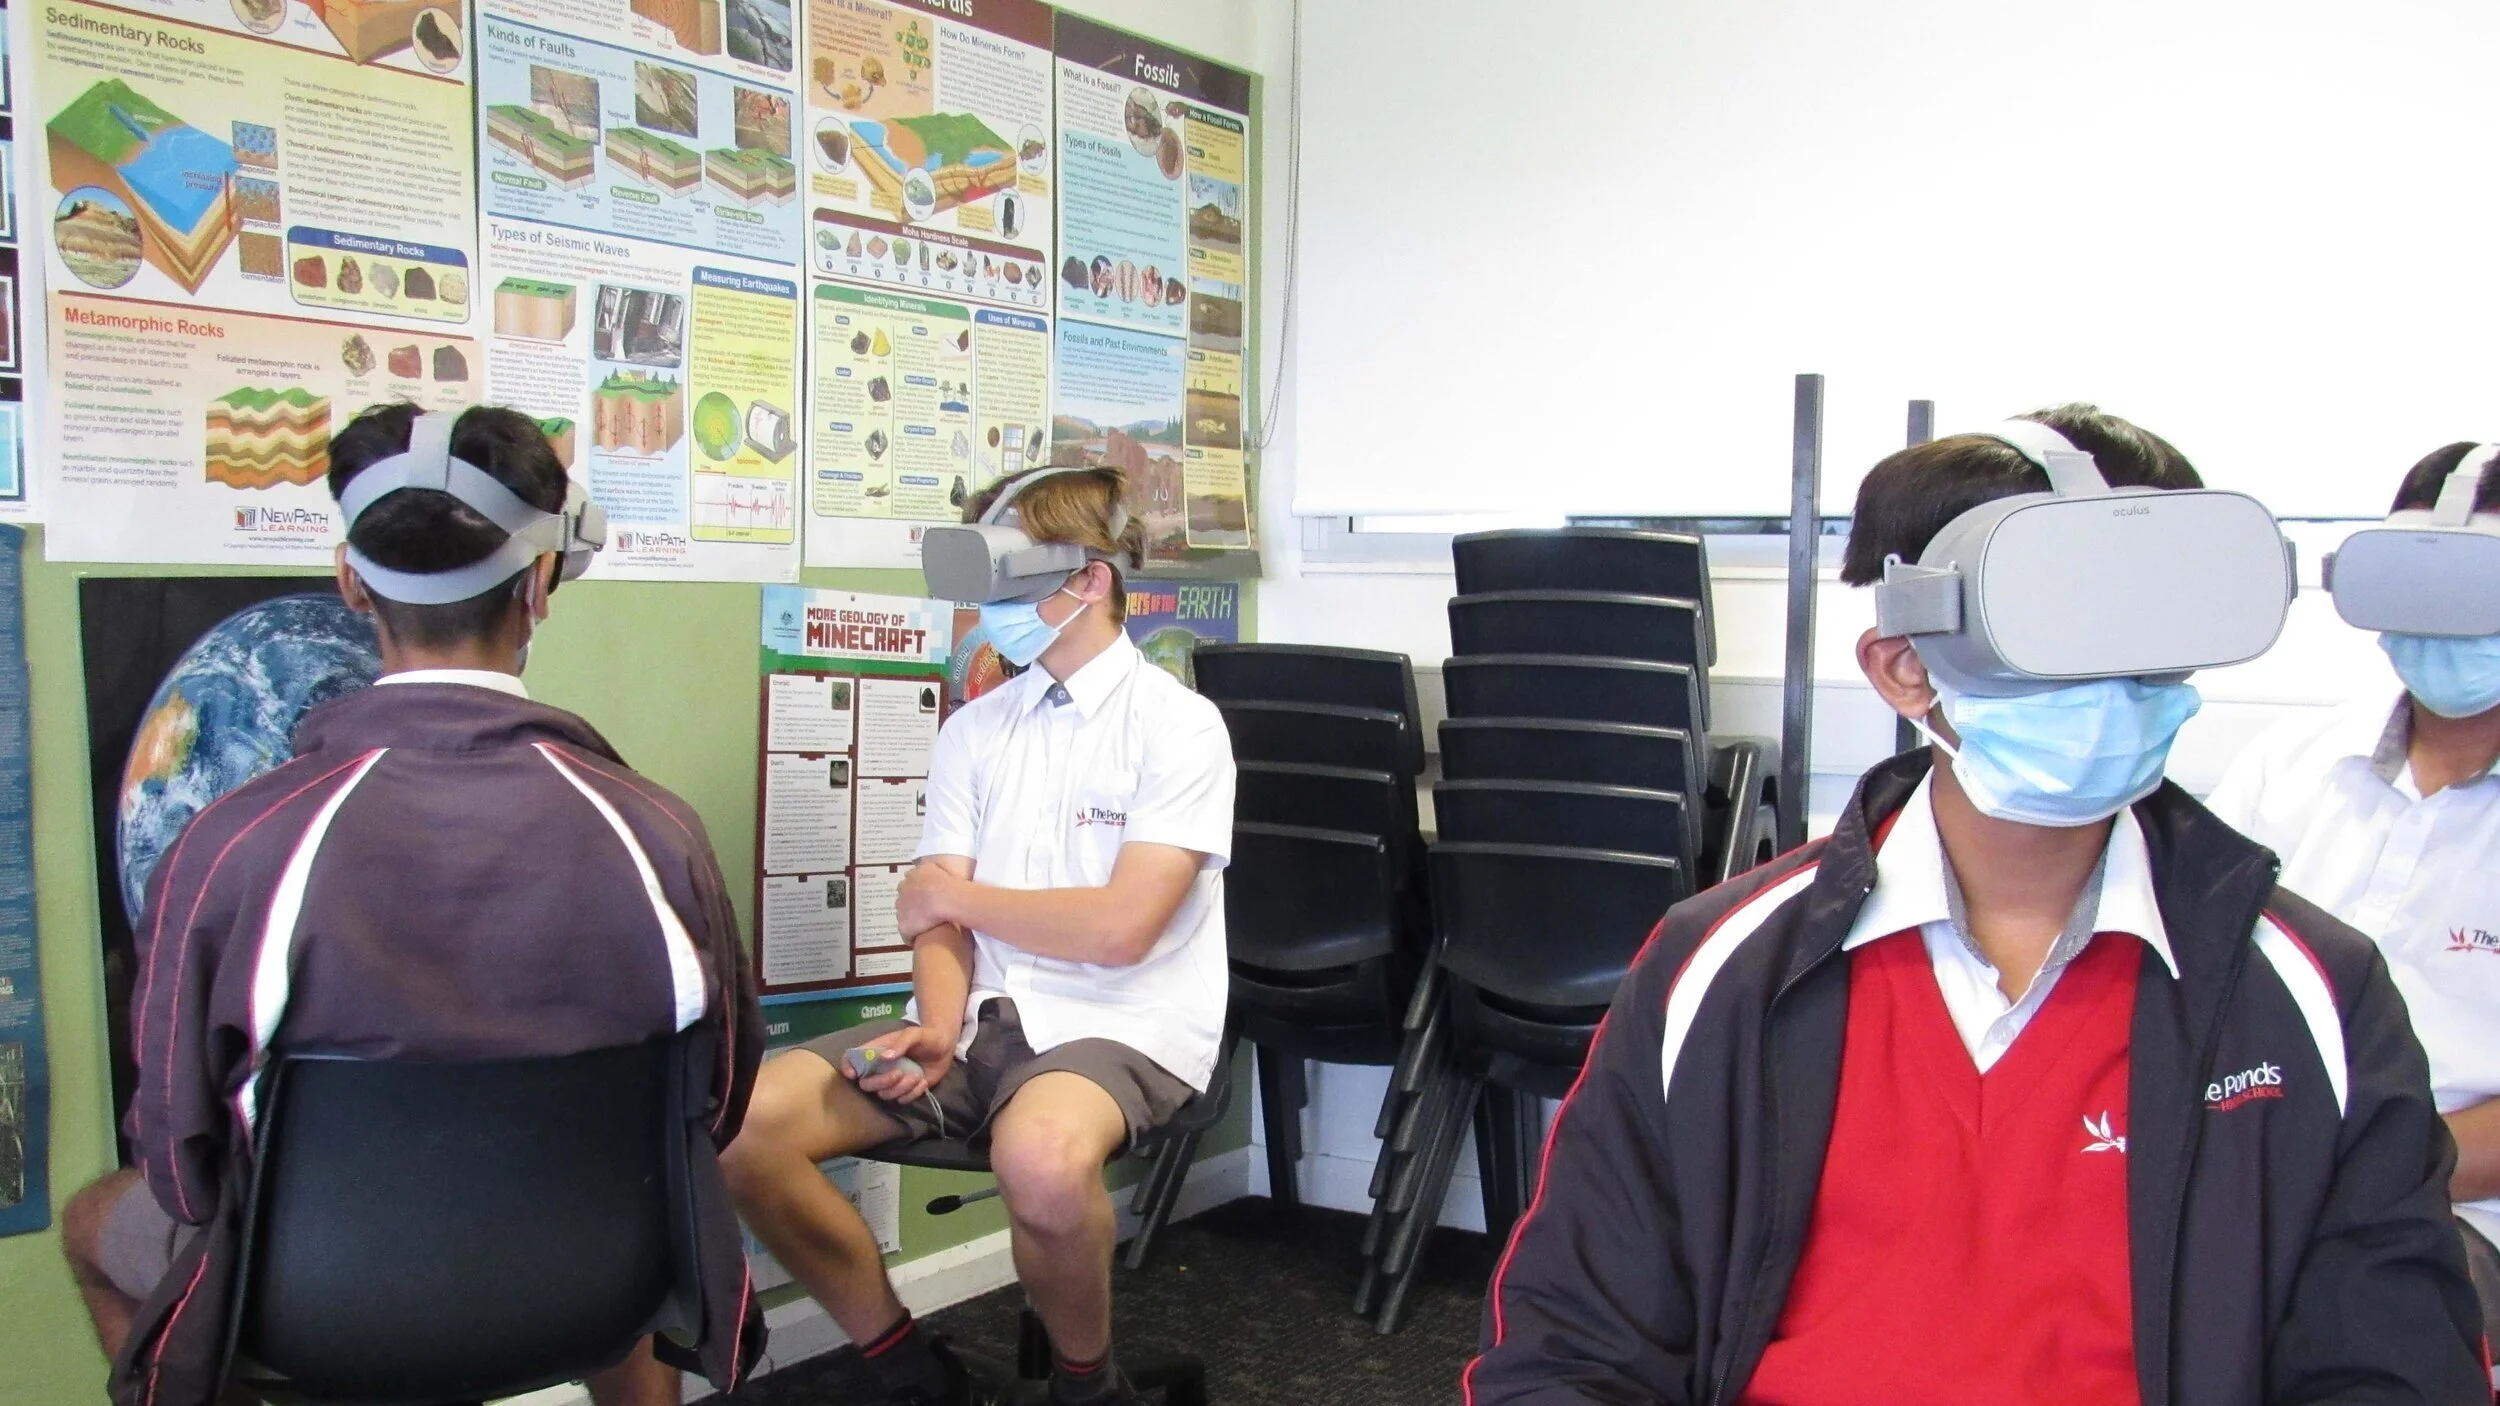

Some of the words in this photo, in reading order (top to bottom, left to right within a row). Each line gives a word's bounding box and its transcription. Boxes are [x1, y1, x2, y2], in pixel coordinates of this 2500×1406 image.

[855, 2, 893, 21] Mineral?
[919, 0, 973, 17] erals
[46, 8, 152, 47] Sedimentary
[158, 31, 205, 54] Rocks
[488, 24, 521, 45] Kinds
[524, 35, 535, 49] of
[540, 38, 576, 58] Faults
[940, 26, 958, 40] How
[960, 32, 969, 44] Do
[971, 36, 1002, 54] Minerals
[1003, 46, 1026, 61] Form?
[1062, 67, 1082, 82] What
[1083, 73, 1089, 83] Is
[1091, 77, 1096, 85] a
[1097, 77, 1121, 94] Fossil?
[1134, 53, 1181, 89] Fossils
[1064, 133, 1086, 150] Types
[1088, 138, 1096, 150] of
[1097, 141, 1121, 158] Fossils
[495, 173, 522, 185] Normal
[523, 180, 543, 189] Fault
[612, 188, 639, 201] Reverse
[640, 192, 658, 203] Fault
[334, 234, 394, 255] Sedimentary
[397, 244, 425, 257] Rocks
[491, 224, 526, 242] Types
[530, 233, 542, 243] of
[546, 233, 590, 252] Seismic
[594, 242, 631, 258] Waves
[920, 228, 951, 242] Hardness
[951, 235, 969, 247] Scale
[701, 270, 741, 288] Measuring
[742, 278, 790, 294] Earthquakes
[863, 293, 899, 309] Identifying
[899, 300, 927, 312] Minerals
[65, 307, 173, 333] Metamorphic
[178, 320, 225, 338] Rocks
[988, 313, 1003, 324] Uses
[1004, 315, 1010, 323] of
[1012, 317, 1036, 328] Minerals
[1063, 331, 1088, 343] Fossils
[1090, 336, 1104, 346] and
[1104, 338, 1121, 349] Past
[1121, 340, 1168, 356] Environments
[2112, 505, 2151, 517] oculus
[261, 525, 329, 534] LEARNING
[1176, 586, 1232, 620] EARTH
[807, 607, 836, 622] MORE
[839, 610, 889, 626] GEOLOGY
[892, 614, 905, 626] OF
[807, 622, 926, 654] MINECRAFT
[1090, 808, 1106, 819] The
[2473, 929, 2499, 947] The
[2224, 1061, 2282, 1098] Ponds
